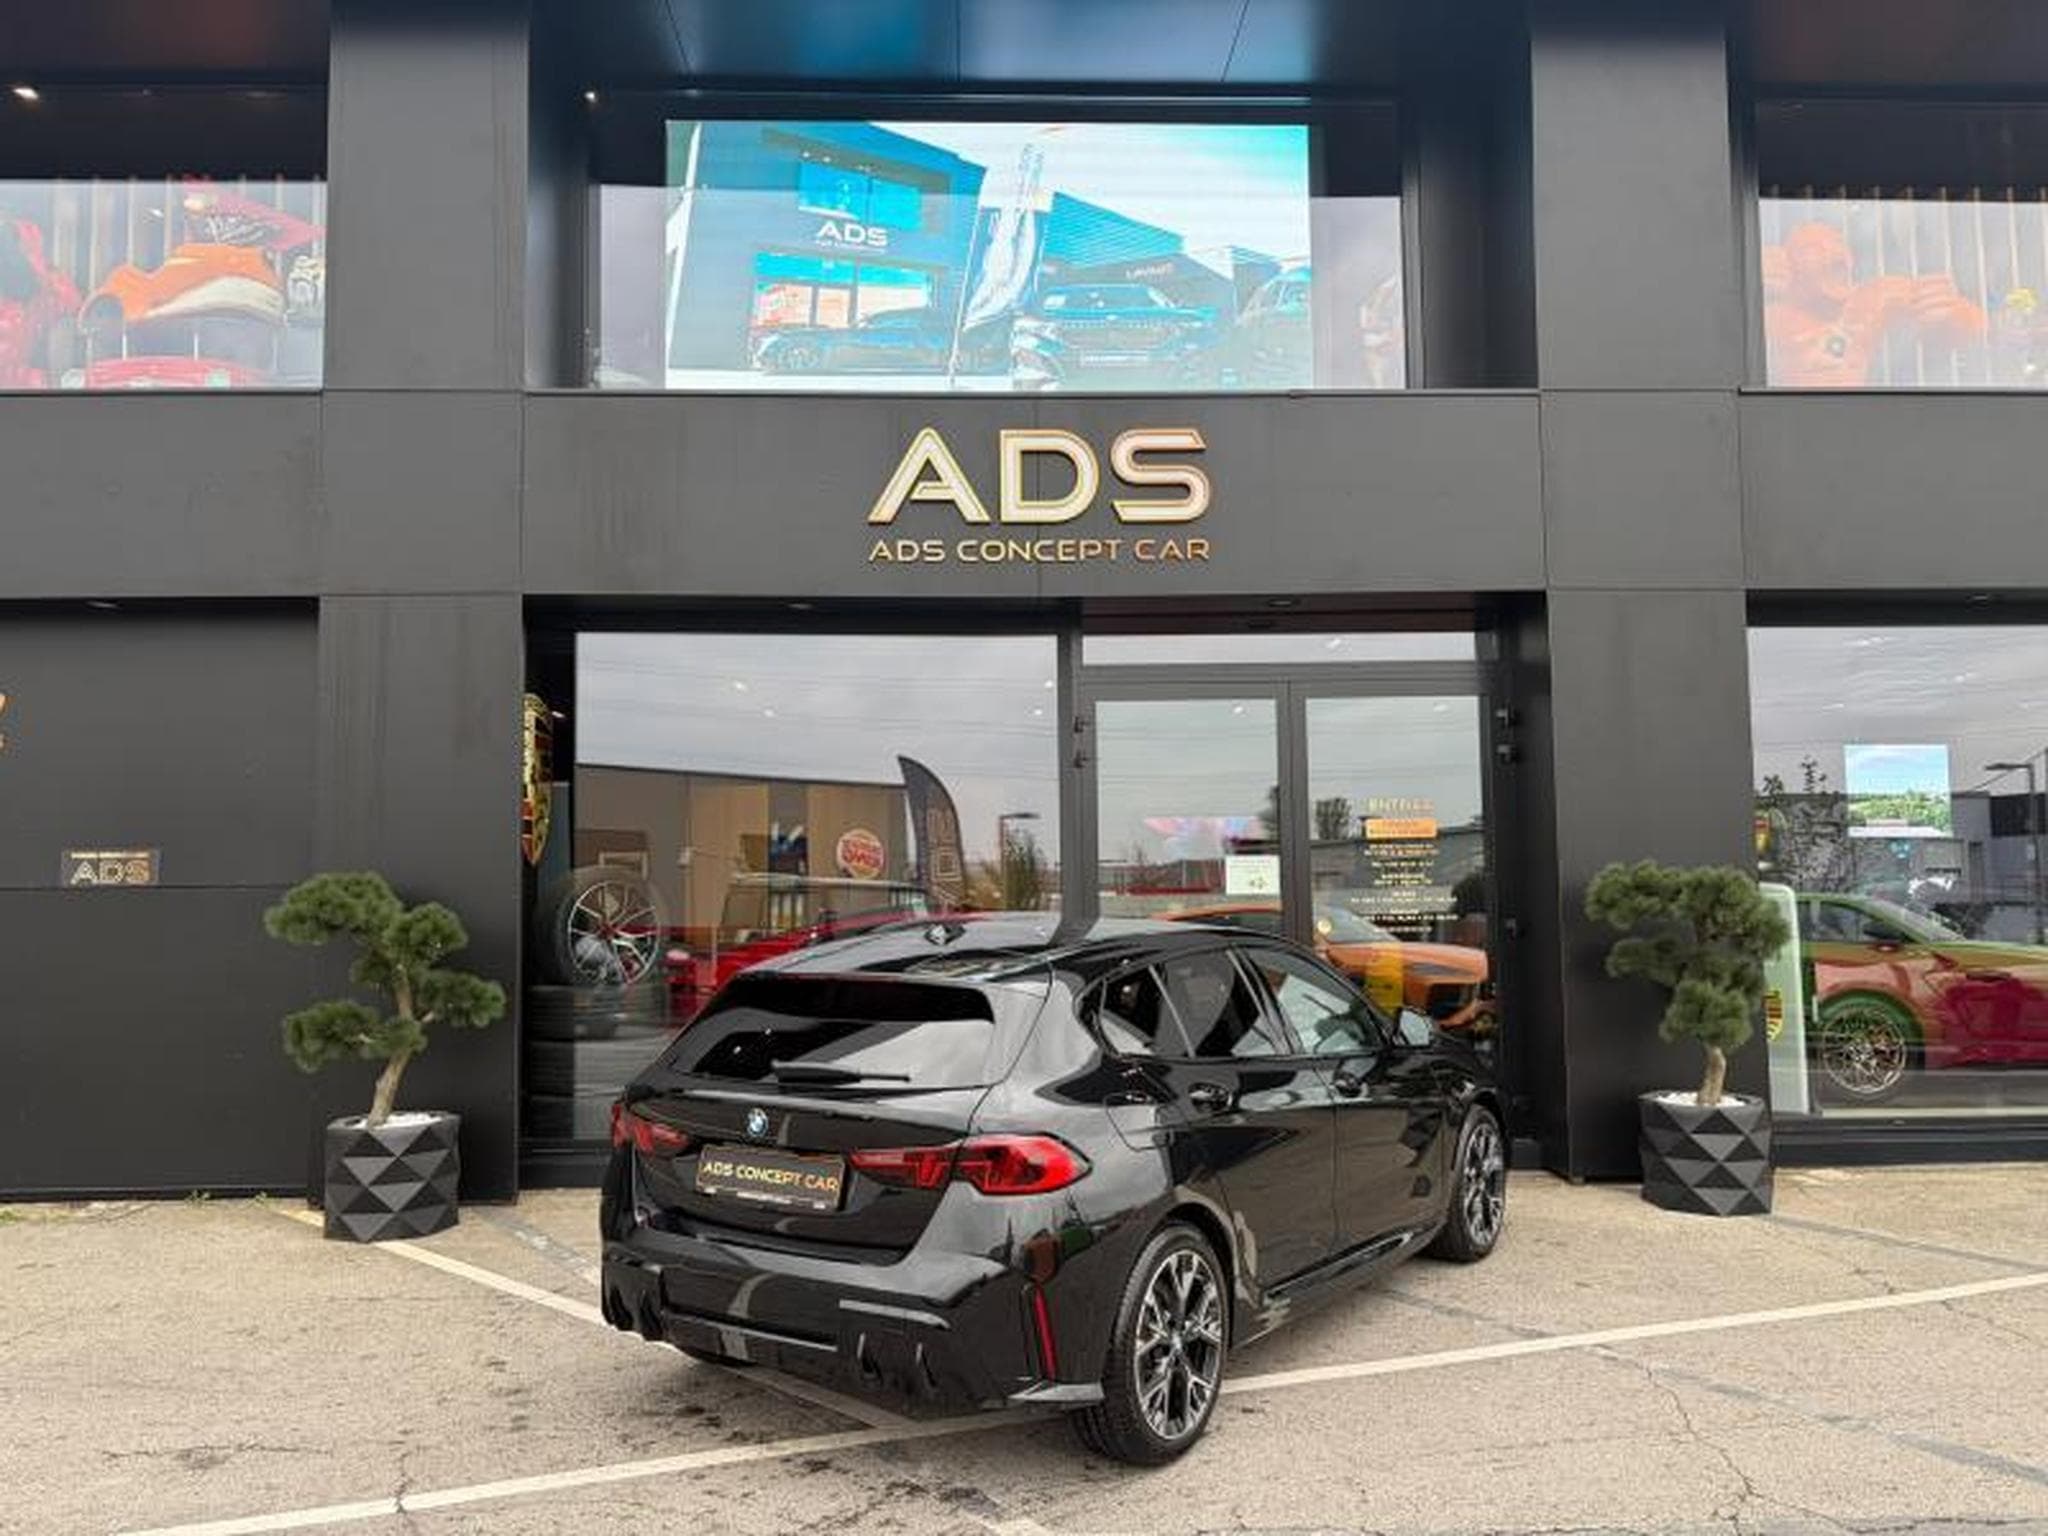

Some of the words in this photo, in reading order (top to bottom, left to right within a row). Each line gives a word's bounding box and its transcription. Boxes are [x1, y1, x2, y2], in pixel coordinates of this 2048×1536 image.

[816, 220, 888, 246] ADS
[867, 427, 1210, 523] ADS
[868, 539, 945, 562] ADS
[957, 538, 1123, 562] CONCEPT
[1135, 538, 1210, 561] CAR
[70, 860, 150, 885] ADS
[703, 1162, 733, 1177] ADS
[736, 1164, 802, 1186] CONCEPT
[805, 1174, 839, 1192] CAR
